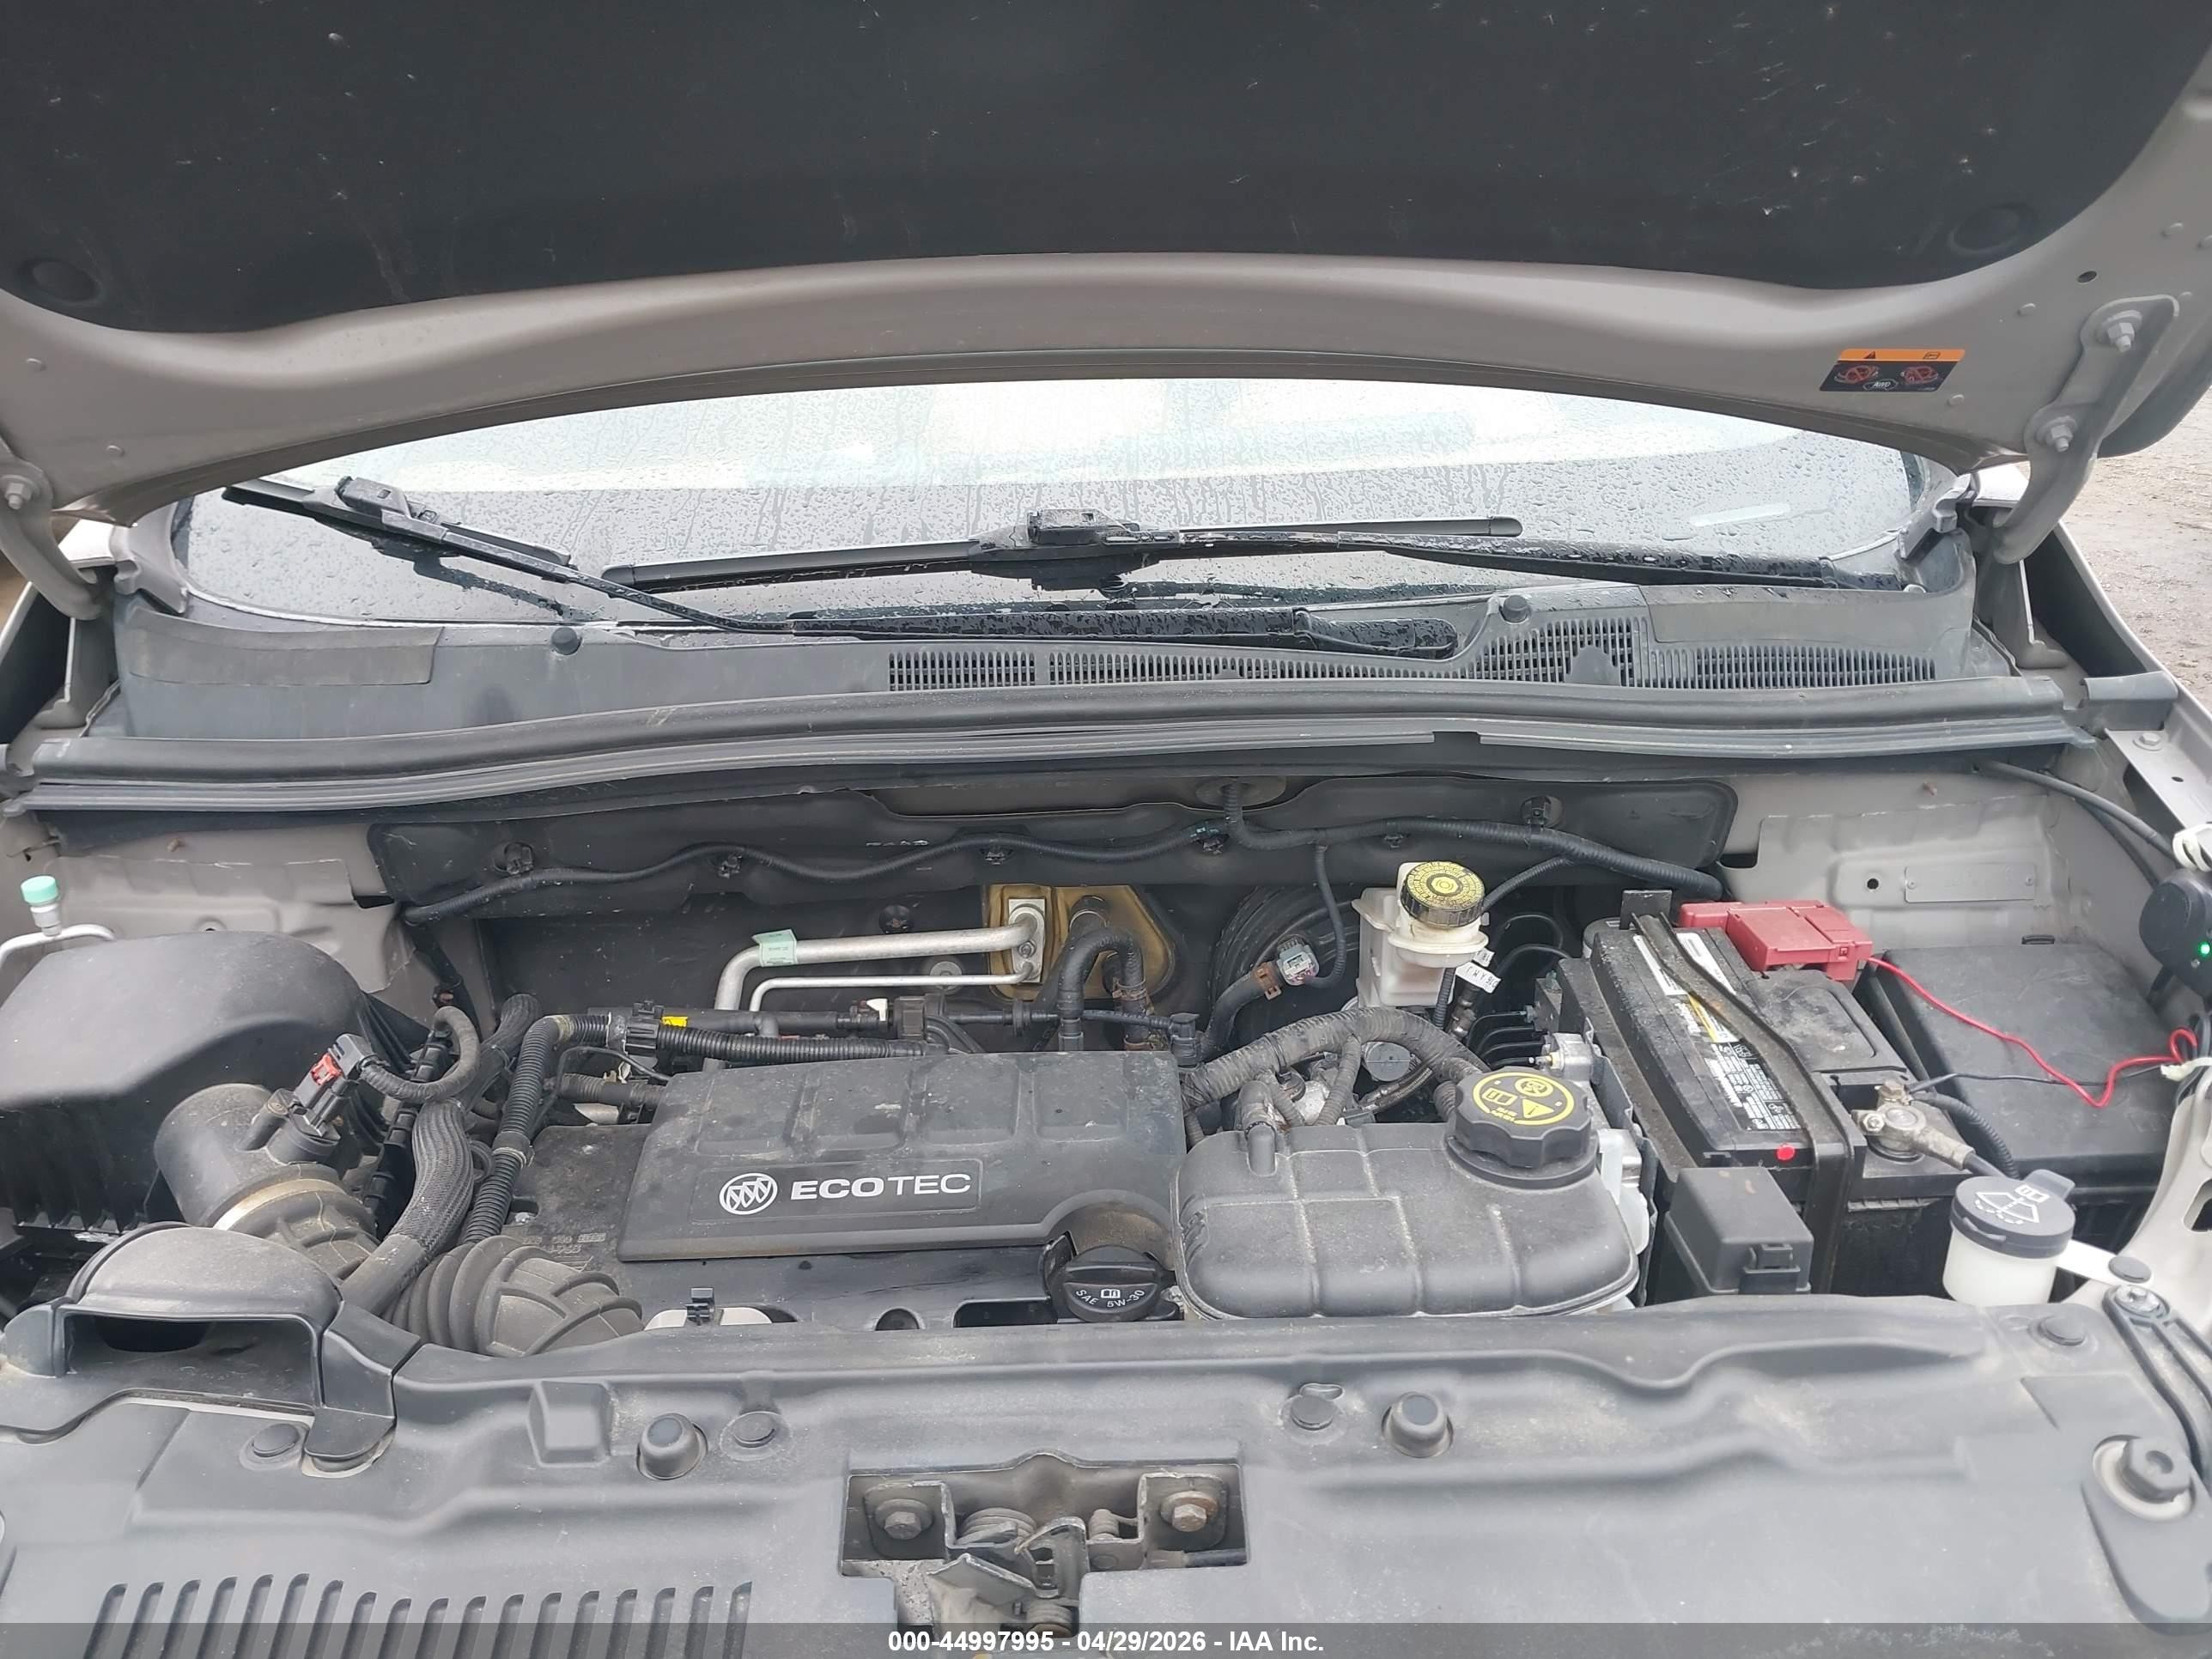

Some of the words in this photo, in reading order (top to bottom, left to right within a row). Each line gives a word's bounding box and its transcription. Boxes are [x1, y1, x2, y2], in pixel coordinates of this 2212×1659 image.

[790, 1173, 971, 1200] ECOTEC
[1075, 1289, 1099, 1305] SAE
[1107, 1290, 1145, 1308] 5W-30
